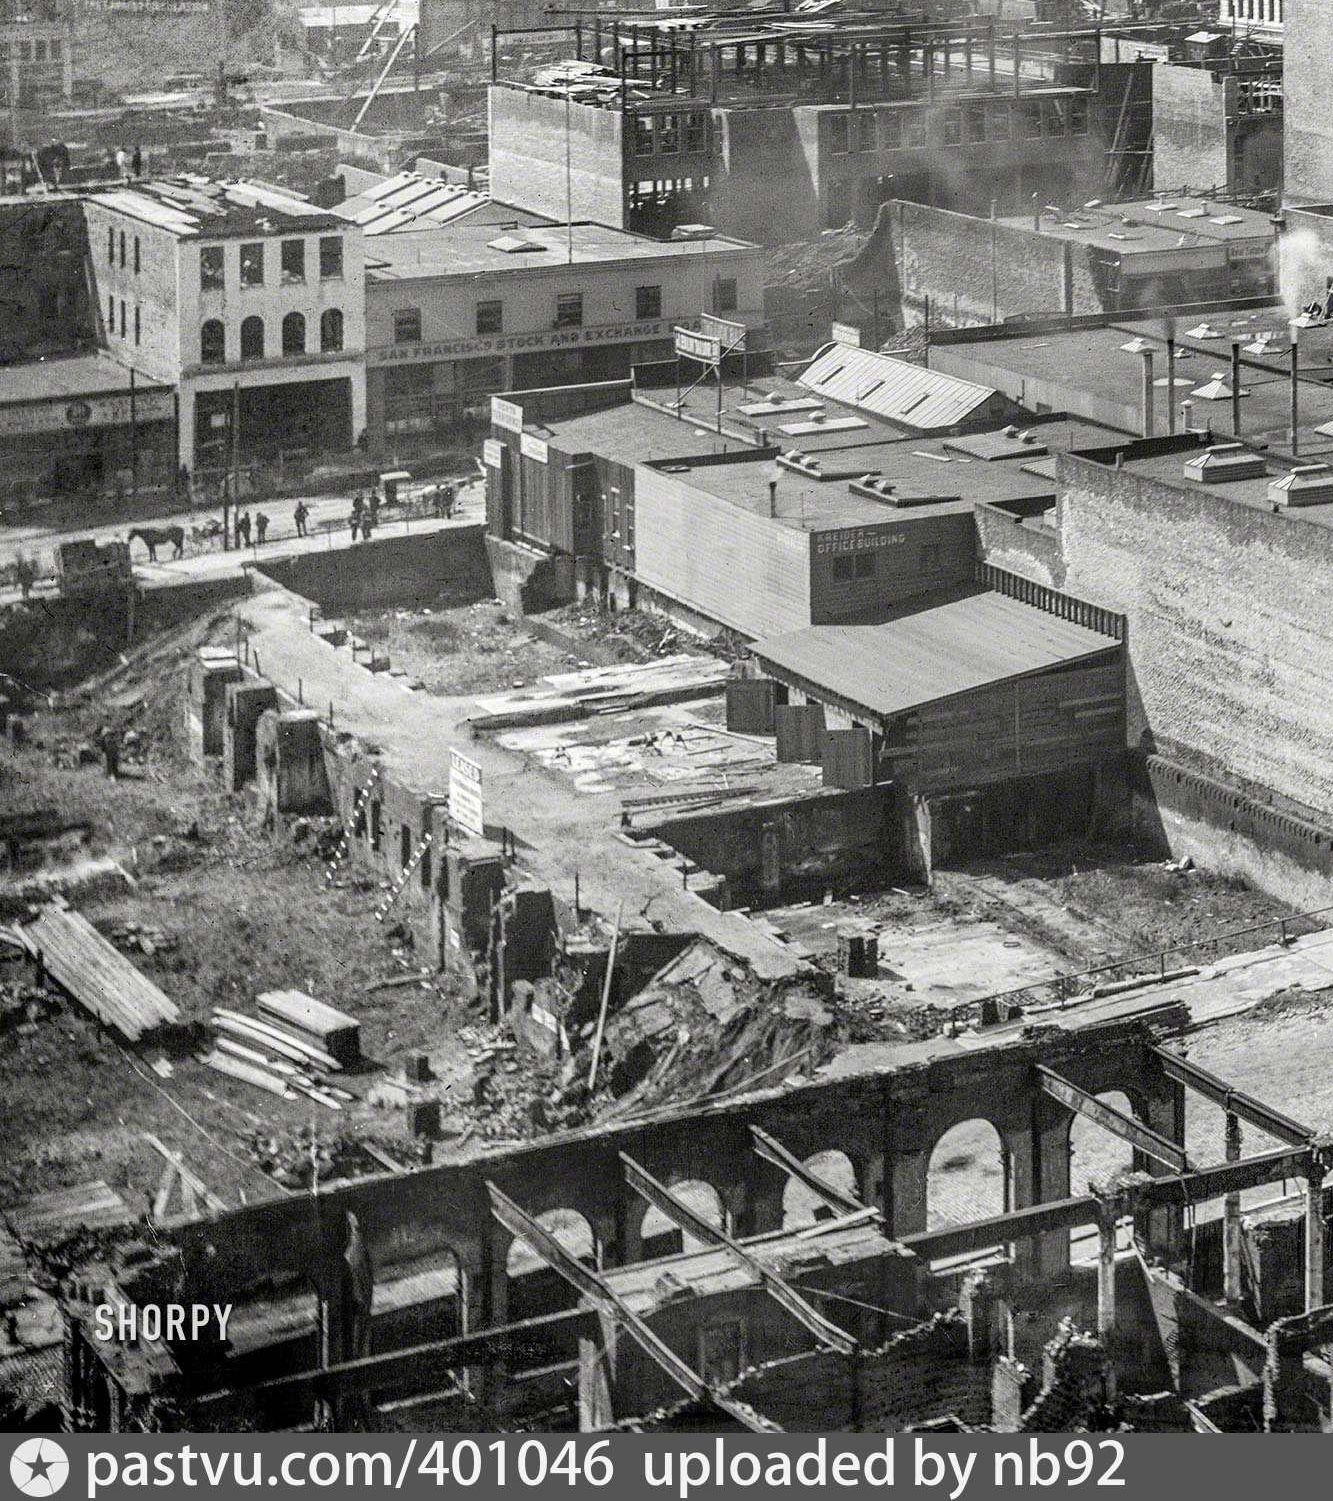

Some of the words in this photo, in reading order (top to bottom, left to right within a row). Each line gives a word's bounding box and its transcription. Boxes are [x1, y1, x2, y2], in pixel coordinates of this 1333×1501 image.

[378, 348, 408, 361] SAN
[413, 340, 493, 357] FRANCISCO
[496, 335, 544, 349] STOCK
[551, 330, 580, 344] AND
[586, 322, 661, 341] EXCHANGE
[817, 539, 856, 554] OFFICE
[857, 533, 905, 550] BUILDING
